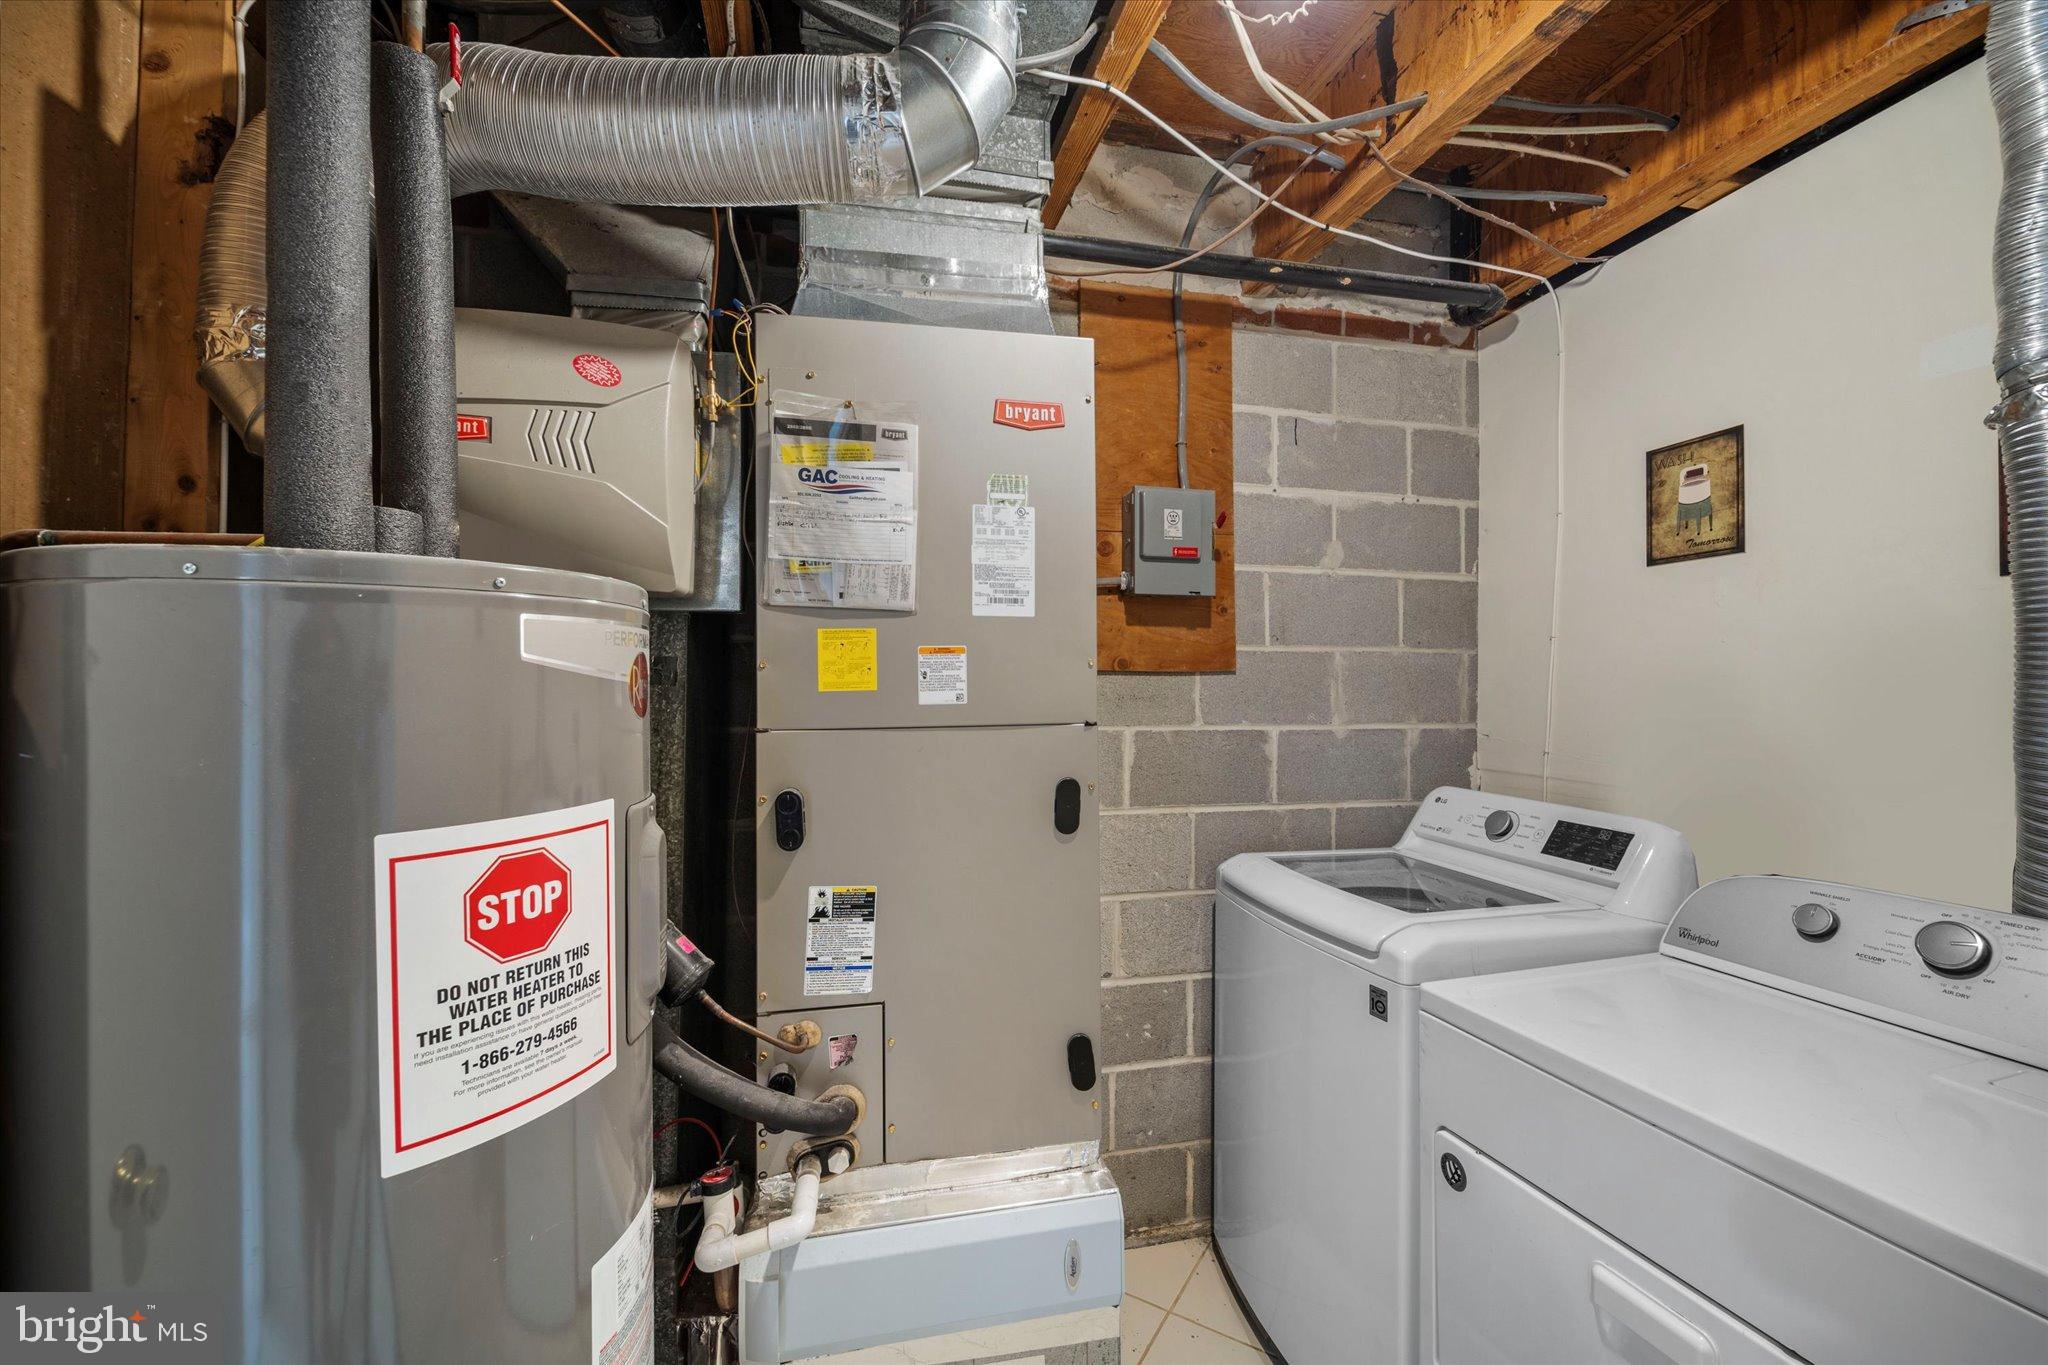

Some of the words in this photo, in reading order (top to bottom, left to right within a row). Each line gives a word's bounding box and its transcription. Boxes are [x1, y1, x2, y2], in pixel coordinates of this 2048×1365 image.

[1005, 403, 1056, 422] bryant
[457, 420, 479, 435] ant
[884, 429, 907, 441] bryant
[1654, 451, 1695, 471] WASH
[798, 467, 838, 484] GAC
[1685, 535, 1735, 549] Tomorrow
[477, 880, 562, 931] STOP
[2000, 920, 2024, 929] TIMED
[1678, 930, 1720, 949] Whirlpool
[1855, 952, 1887, 963] ACCUDRY
[437, 984, 461, 1004] DO
[467, 974, 500, 997] NOT
[505, 954, 561, 985] RETURN
[565, 942, 590, 964] THIS
[449, 991, 508, 1020] WATER
[513, 970, 565, 1001] HEATER
[569, 962, 583, 980] TO
[1942, 988, 1955, 996] AIR
[1955, 991, 1971, 1000] DRY
[416, 1025, 453, 1048] THE
[459, 1007, 512, 1037] PLACE
[517, 999, 535, 1017] OF
[540, 970, 601, 1009] PURCHASE
[413, 1058, 434, 1069] need
[435, 1046, 474, 1061] installation
[474, 1034, 510, 1051] assistance
[518, 1023, 533, 1033] have
[533, 1016, 553, 1030] general
[554, 1006, 579, 1020] questions
[420, 1049, 435, 1060] you
[436, 1045, 449, 1053] are
[450, 1030, 495, 1050] experiencing
[495, 1024, 516, 1036] issues
[541, 1008, 556, 1018] water
[461, 1017, 578, 1075] 1-866-279-4566
[453, 1088, 467, 1098] For
[467, 1083, 485, 1093] more
[524, 1063, 535, 1071] see
[535, 1057, 545, 1065] the
[461, 1068, 501, 1086] Technicians
[501, 1063, 513, 1073] are
[513, 1053, 539, 1068] available
[545, 1043, 559, 1055] days
[476, 1081, 507, 1098] provided
[507, 1074, 520, 1085] with
[520, 1070, 535, 1081] your
[535, 1063, 550, 1073] water
